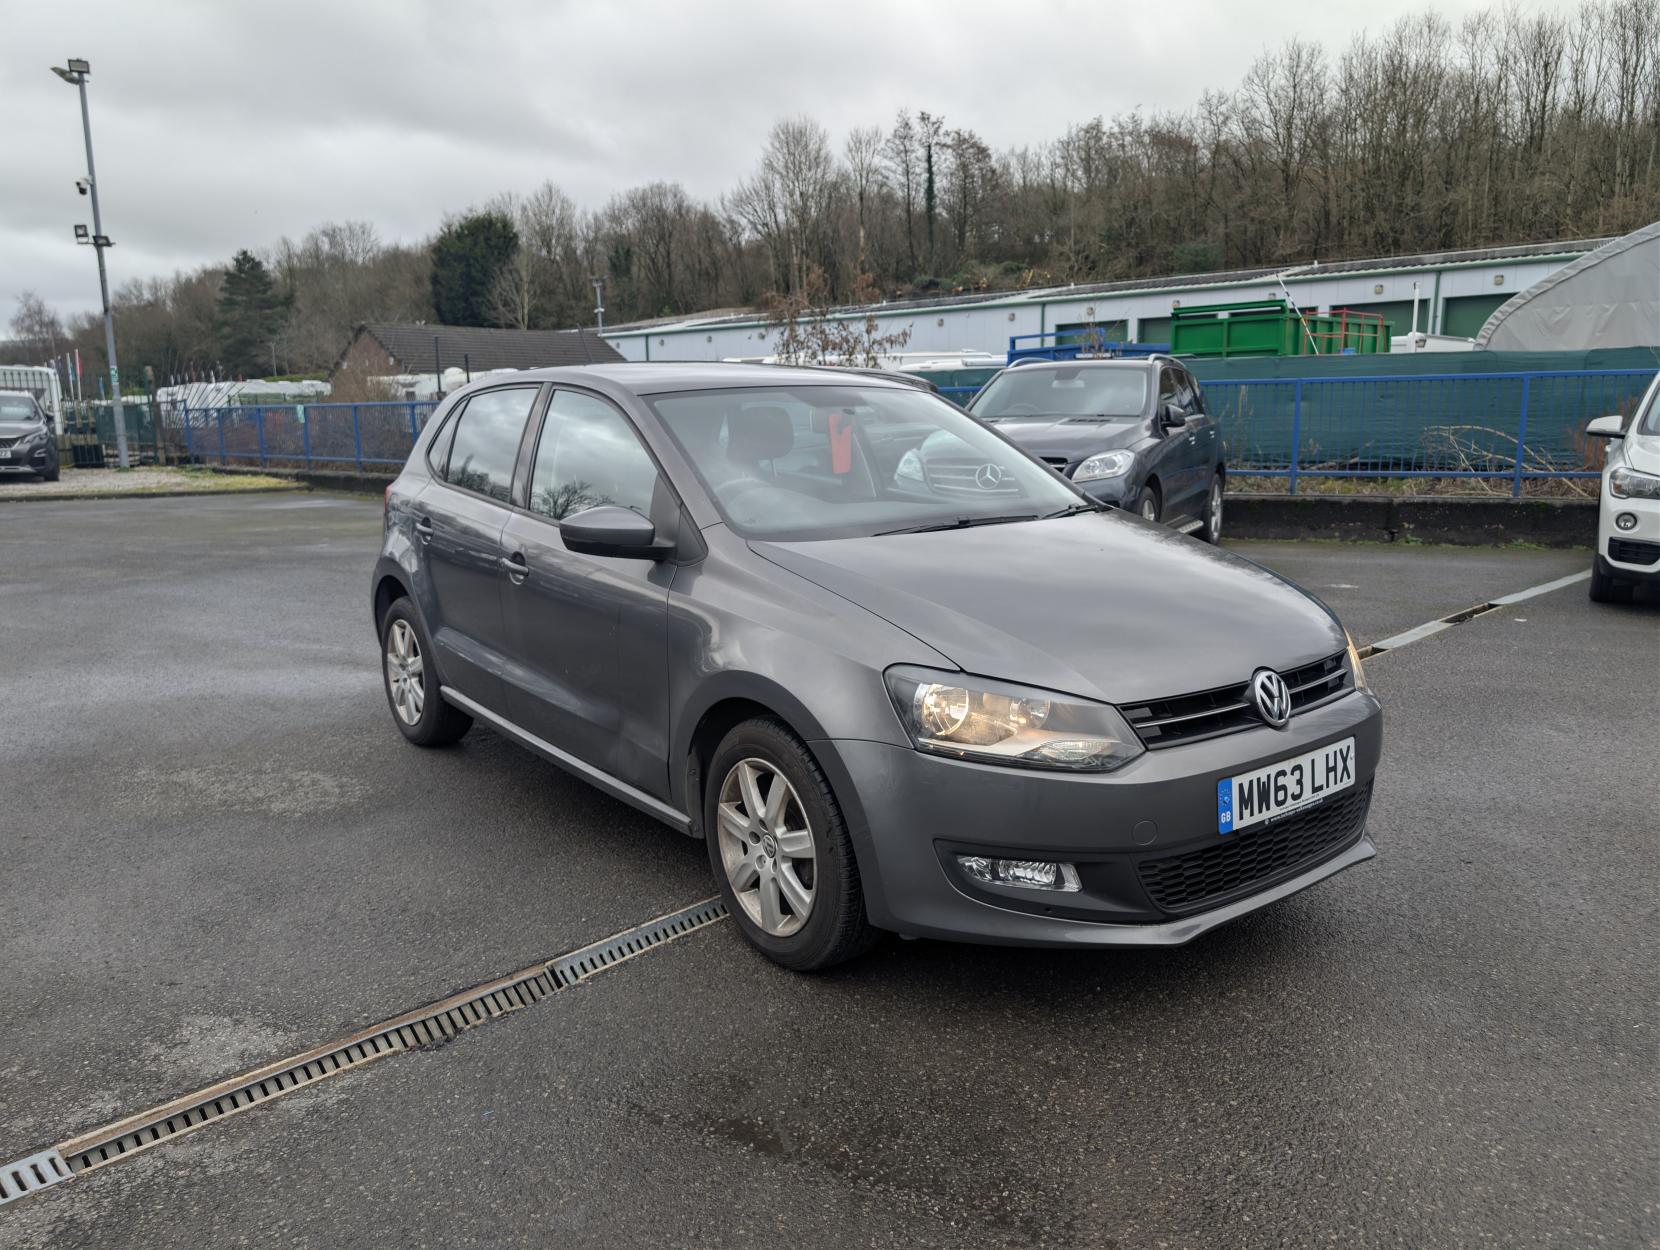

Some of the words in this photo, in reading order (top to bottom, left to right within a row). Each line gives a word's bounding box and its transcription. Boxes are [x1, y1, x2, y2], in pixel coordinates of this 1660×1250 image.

[1239, 764, 1304, 821] MW63
[1311, 745, 1351, 795] LHX
[1221, 811, 1231, 824] GB
